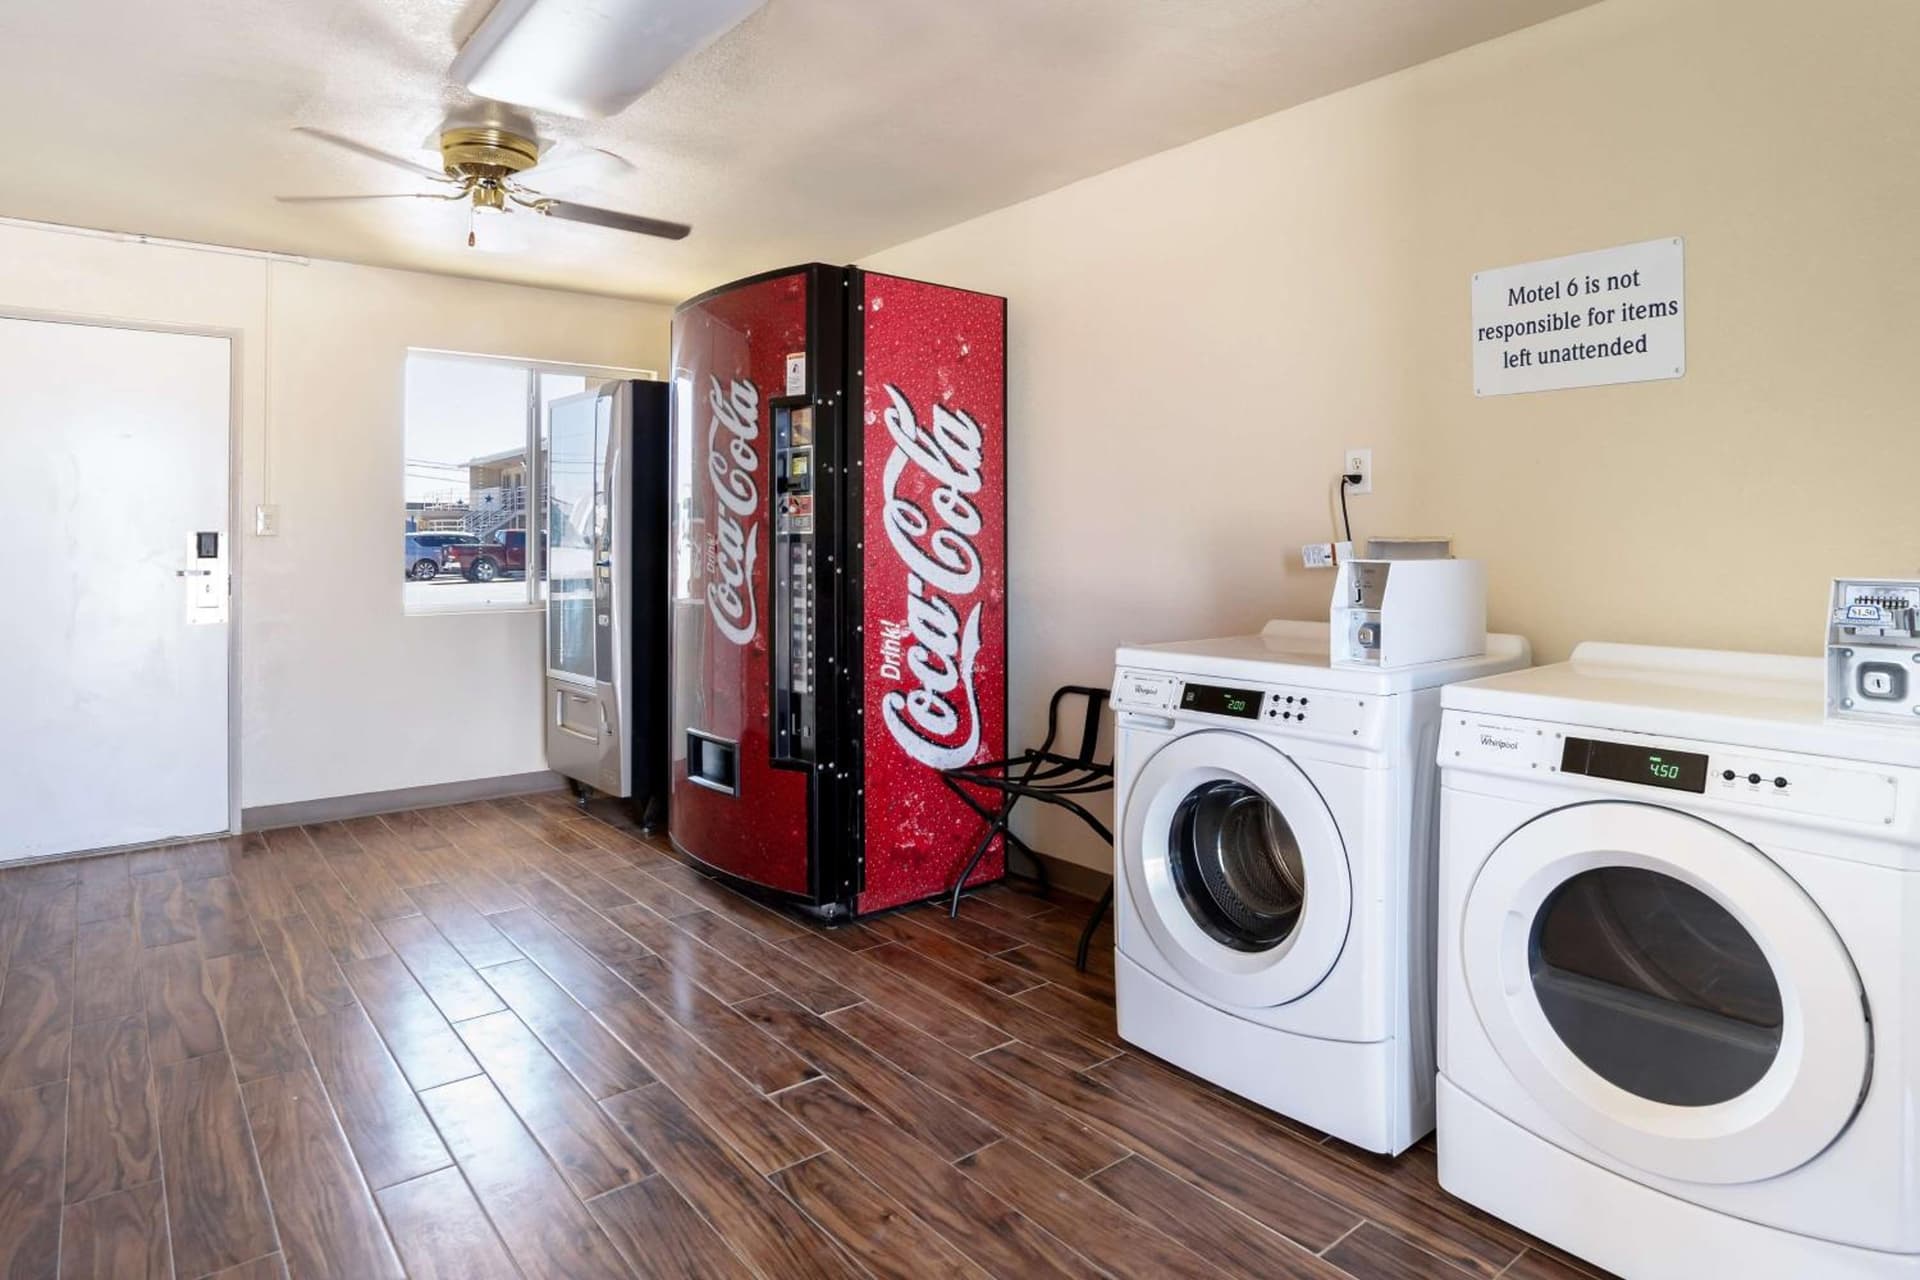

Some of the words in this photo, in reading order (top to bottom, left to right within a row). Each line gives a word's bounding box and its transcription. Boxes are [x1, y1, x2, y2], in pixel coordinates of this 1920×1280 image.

[1508, 281, 1560, 307] Motel
[1567, 277, 1579, 297] 6
[1584, 276, 1600, 294] is
[1607, 269, 1641, 292] not
[1478, 311, 1581, 342] responsible
[1588, 307, 1615, 326] for
[1621, 299, 1679, 322] items
[1503, 348, 1532, 368] left
[1538, 333, 1648, 365] unattended
[883, 383, 984, 770] Coca-Cola
[880, 619, 902, 680] Drink!
[1479, 735, 1519, 750] Whirlpool
